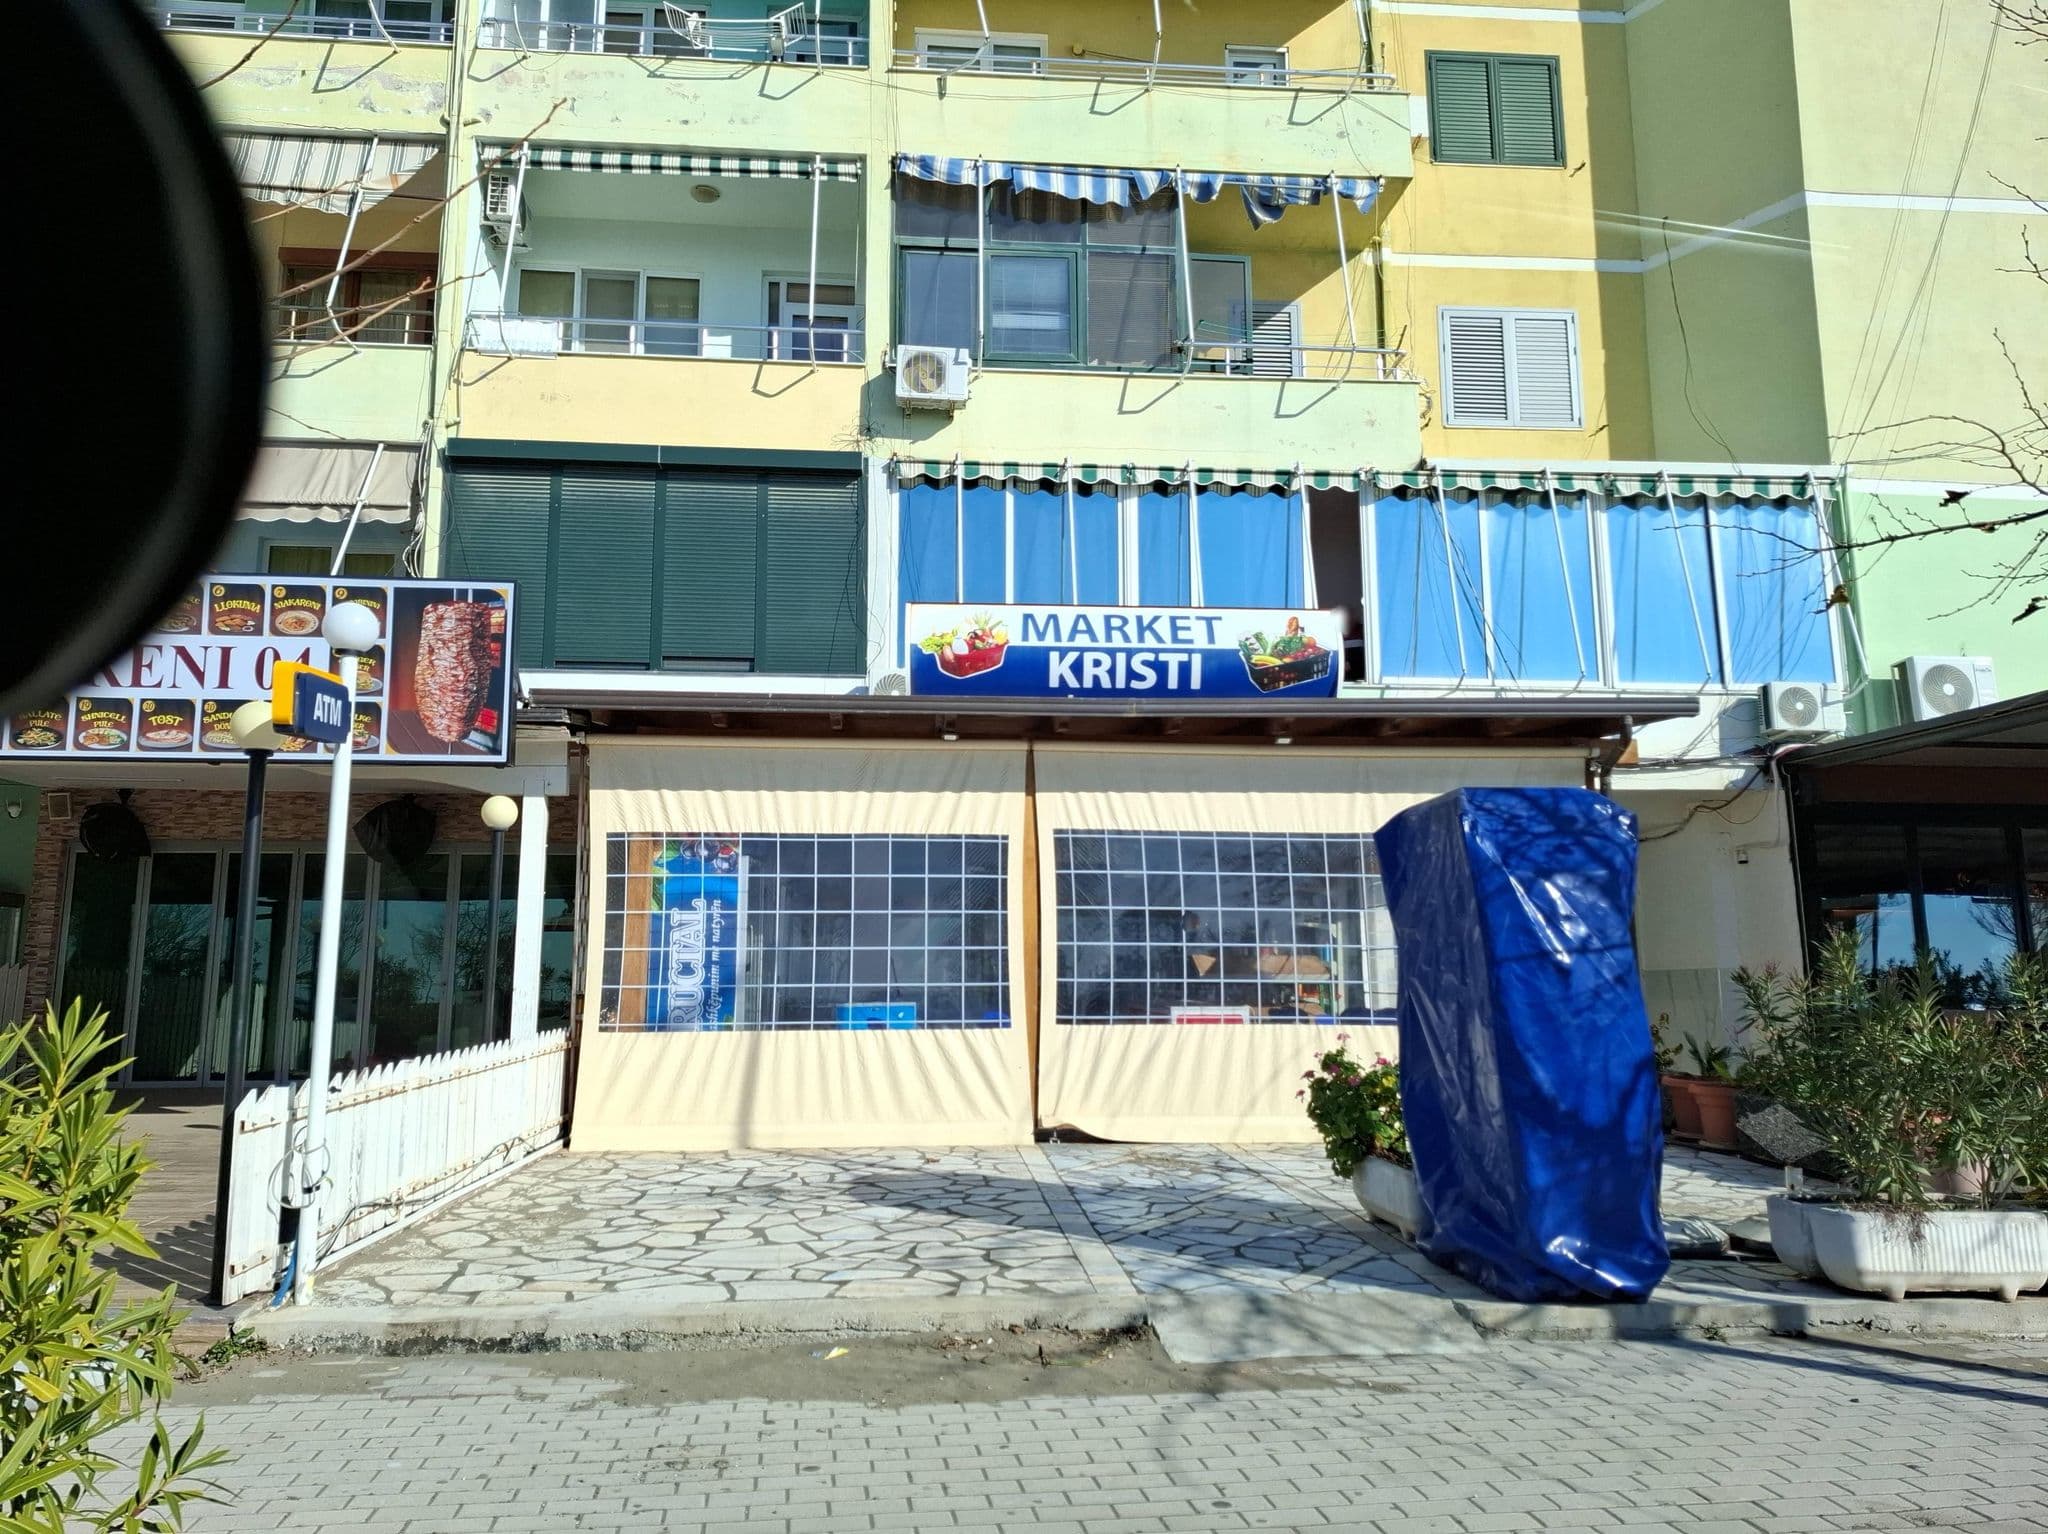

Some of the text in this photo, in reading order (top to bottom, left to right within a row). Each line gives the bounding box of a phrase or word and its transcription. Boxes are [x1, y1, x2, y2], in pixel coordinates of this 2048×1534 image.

[1021, 613, 1222, 645] MARKET
[1049, 651, 1202, 690] KRISTI
[148, 714, 184, 726] TOST
[313, 692, 342, 727] ATM
[667, 898, 707, 1032] RUCTAL
